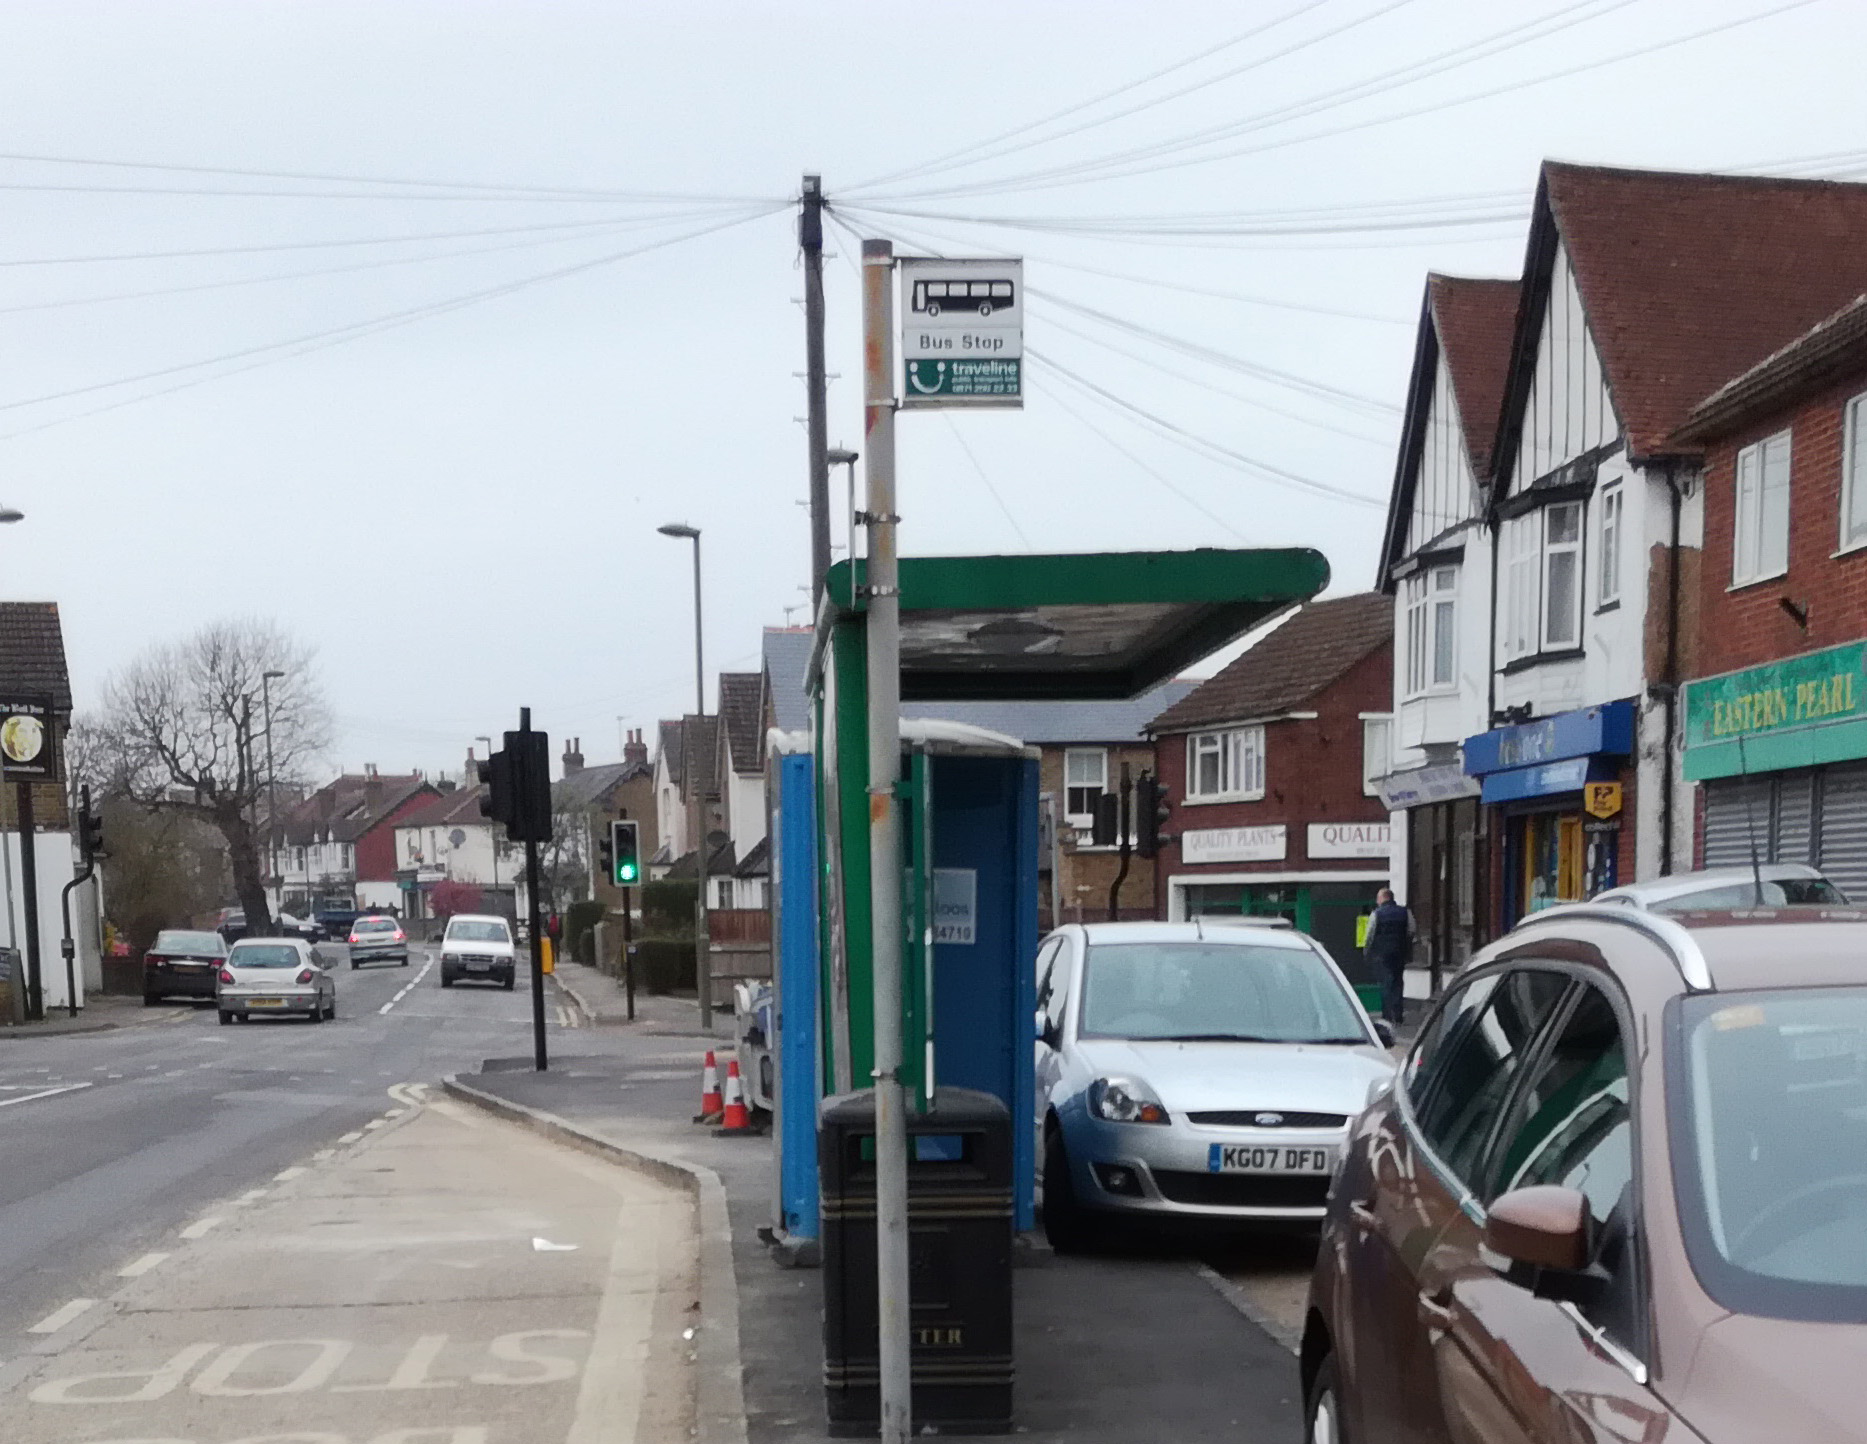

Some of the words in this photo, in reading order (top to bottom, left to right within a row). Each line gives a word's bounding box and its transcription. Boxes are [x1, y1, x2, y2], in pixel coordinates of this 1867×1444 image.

[919, 334, 953, 350] Bus
[961, 334, 1004, 352] Stop
[952, 360, 1018, 376] traveline
[1713, 689, 1787, 736] EASTERN
[1794, 672, 1855, 721] PEARL
[1190, 833, 1233, 851] QUALITY
[1237, 829, 1278, 847] PLANTS
[1322, 826, 1391, 846] QUALIT
[1223, 1147, 1280, 1169] KG07
[1284, 1149, 1326, 1171] DFD
[27, 1328, 593, 1405] STOP
